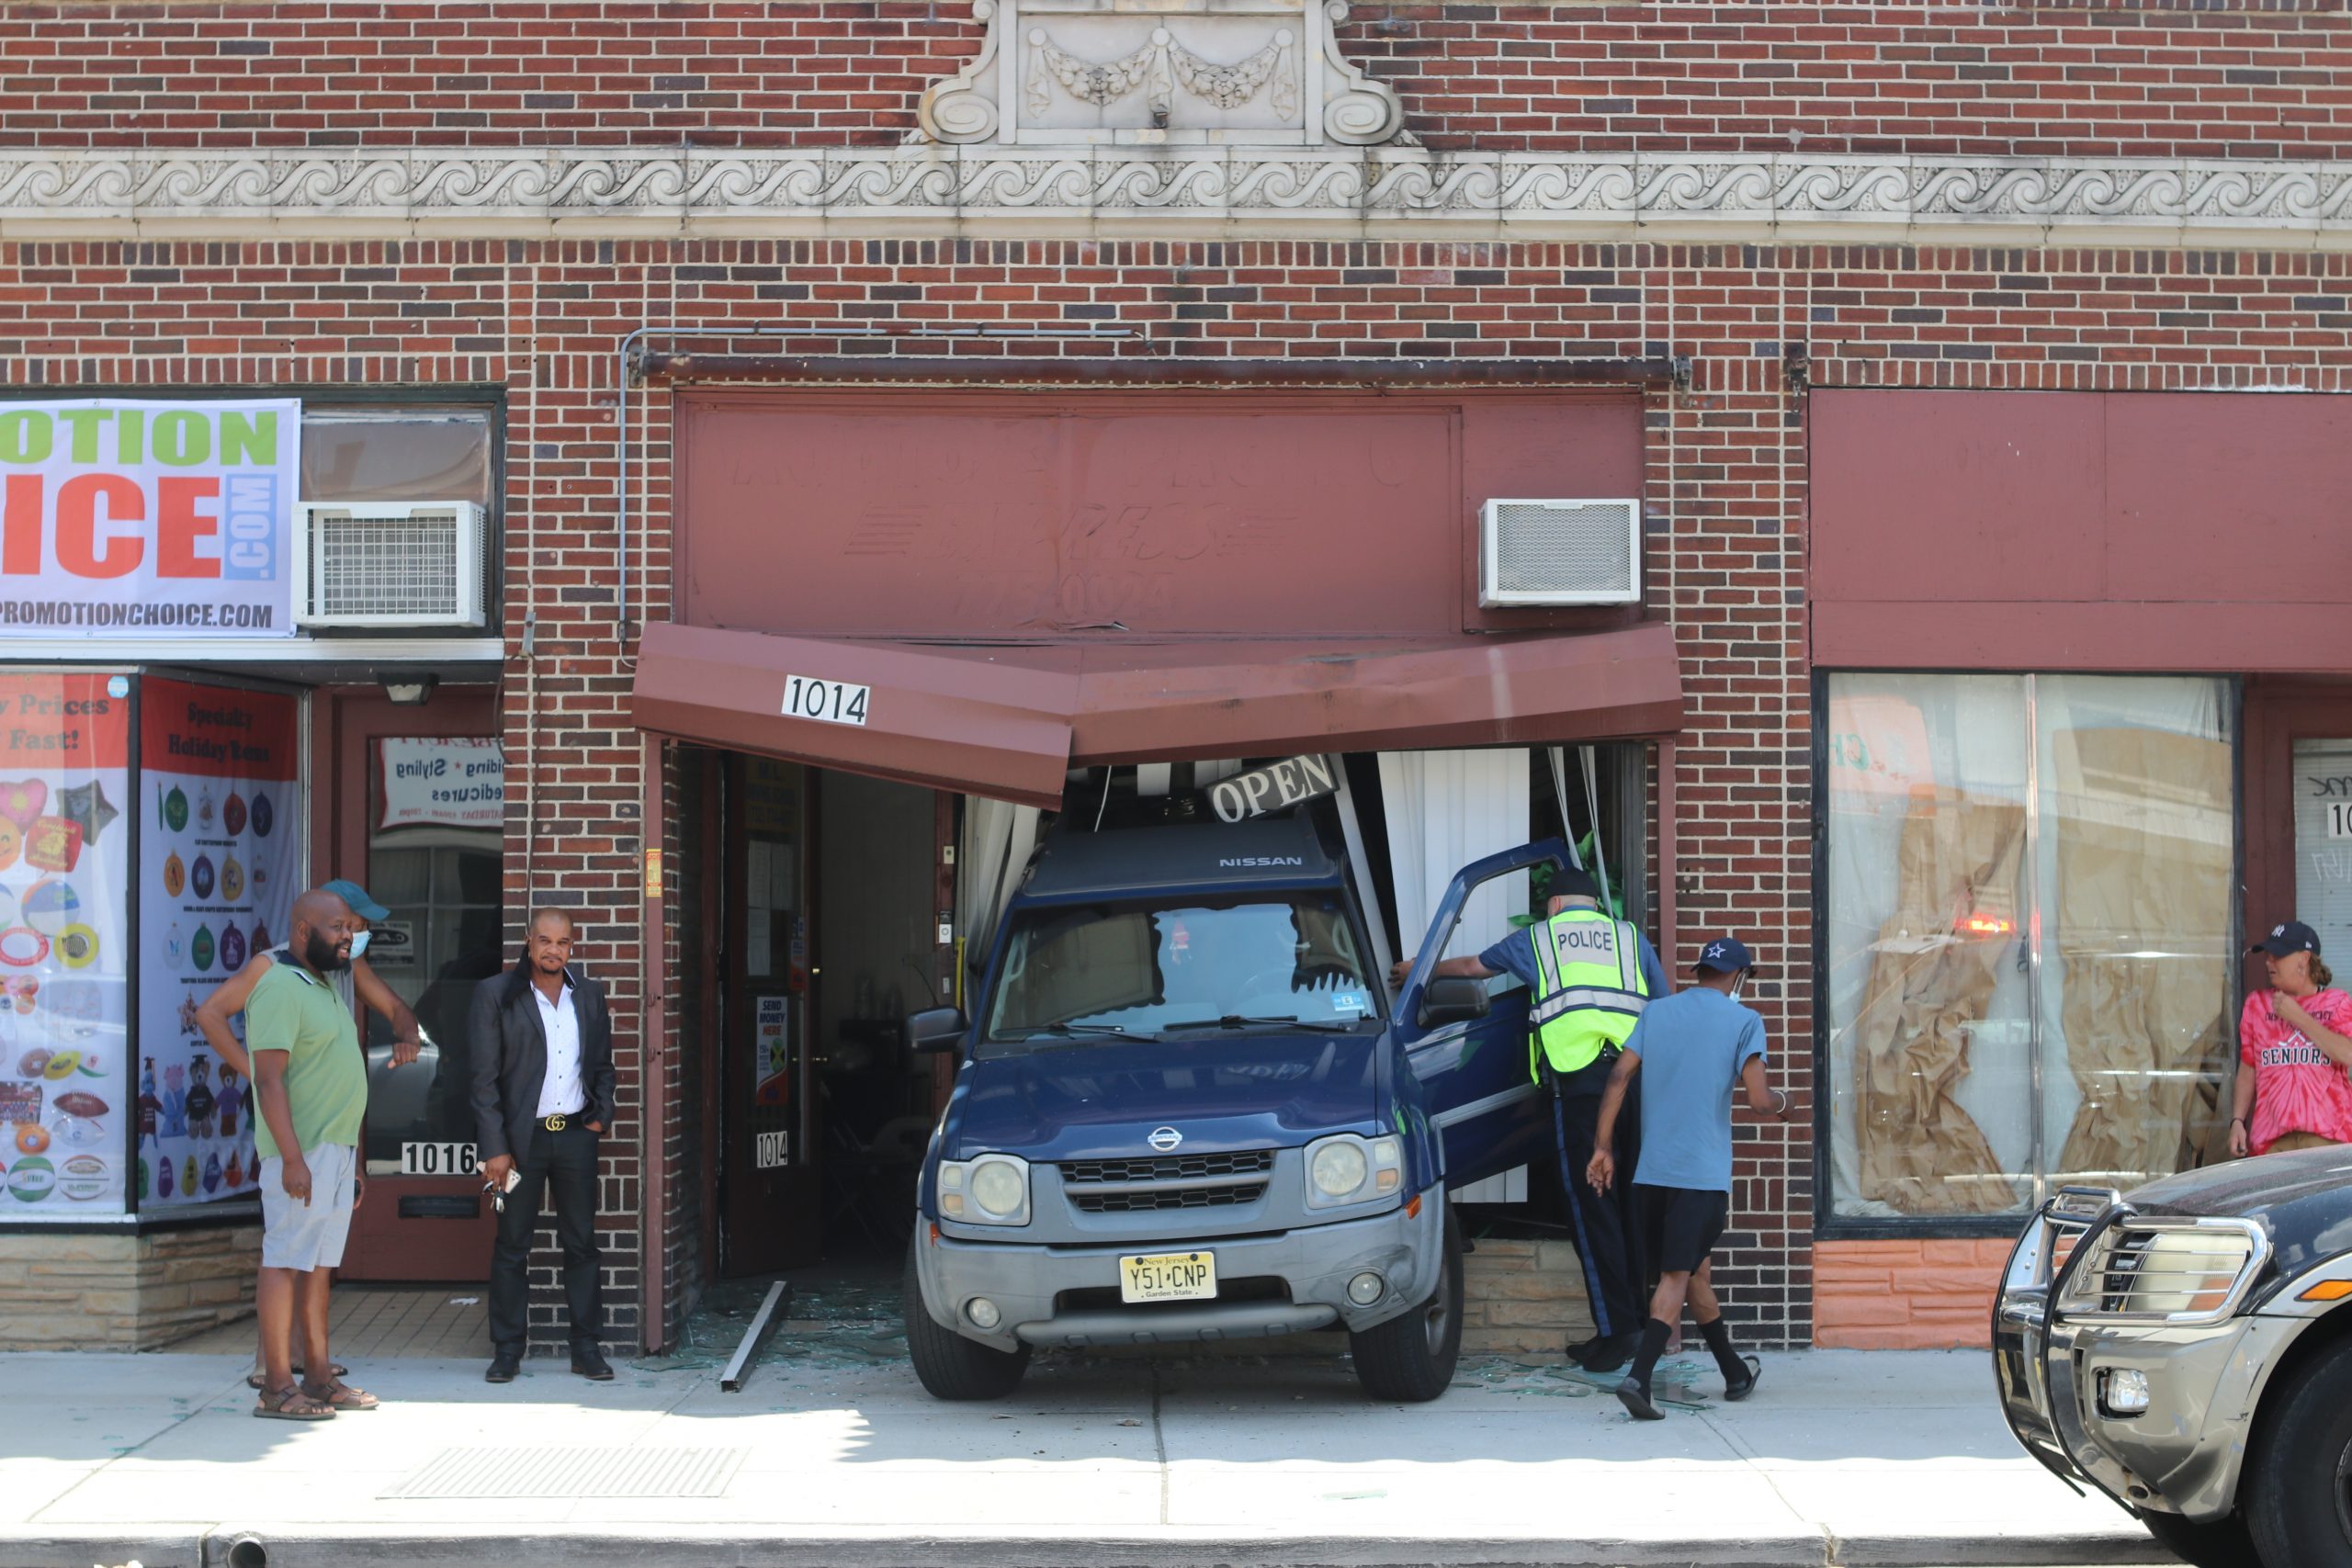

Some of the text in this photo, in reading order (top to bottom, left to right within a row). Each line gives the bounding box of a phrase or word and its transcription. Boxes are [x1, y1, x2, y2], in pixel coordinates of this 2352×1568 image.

[0, 410, 277, 466] OTION
[2, 473, 220, 579] ICE
[230, 478, 271, 579] .COM
[0, 600, 273, 629] ROMOTIONCHOICE.COM
[19, 693, 109, 716] Prices
[792, 678, 866, 723] 1014
[187, 701, 254, 732] Specialty
[9, 728, 79, 750] Fast!
[168, 733, 270, 763] Holiday Items
[1212, 753, 1333, 823] OPEN
[1219, 856, 1302, 867] NISSAN
[1557, 931, 1612, 952] POLICE
[759, 1012, 786, 1023] MONEY
[763, 999, 782, 1010] SEND
[763, 1025, 782, 1036] HERE
[2261, 1046, 2332, 1066] SENIORS
[406, 1144, 475, 1173] 1016
[759, 1132, 787, 1167] 1014
[1144, 1256, 1192, 1266] New Jersey
